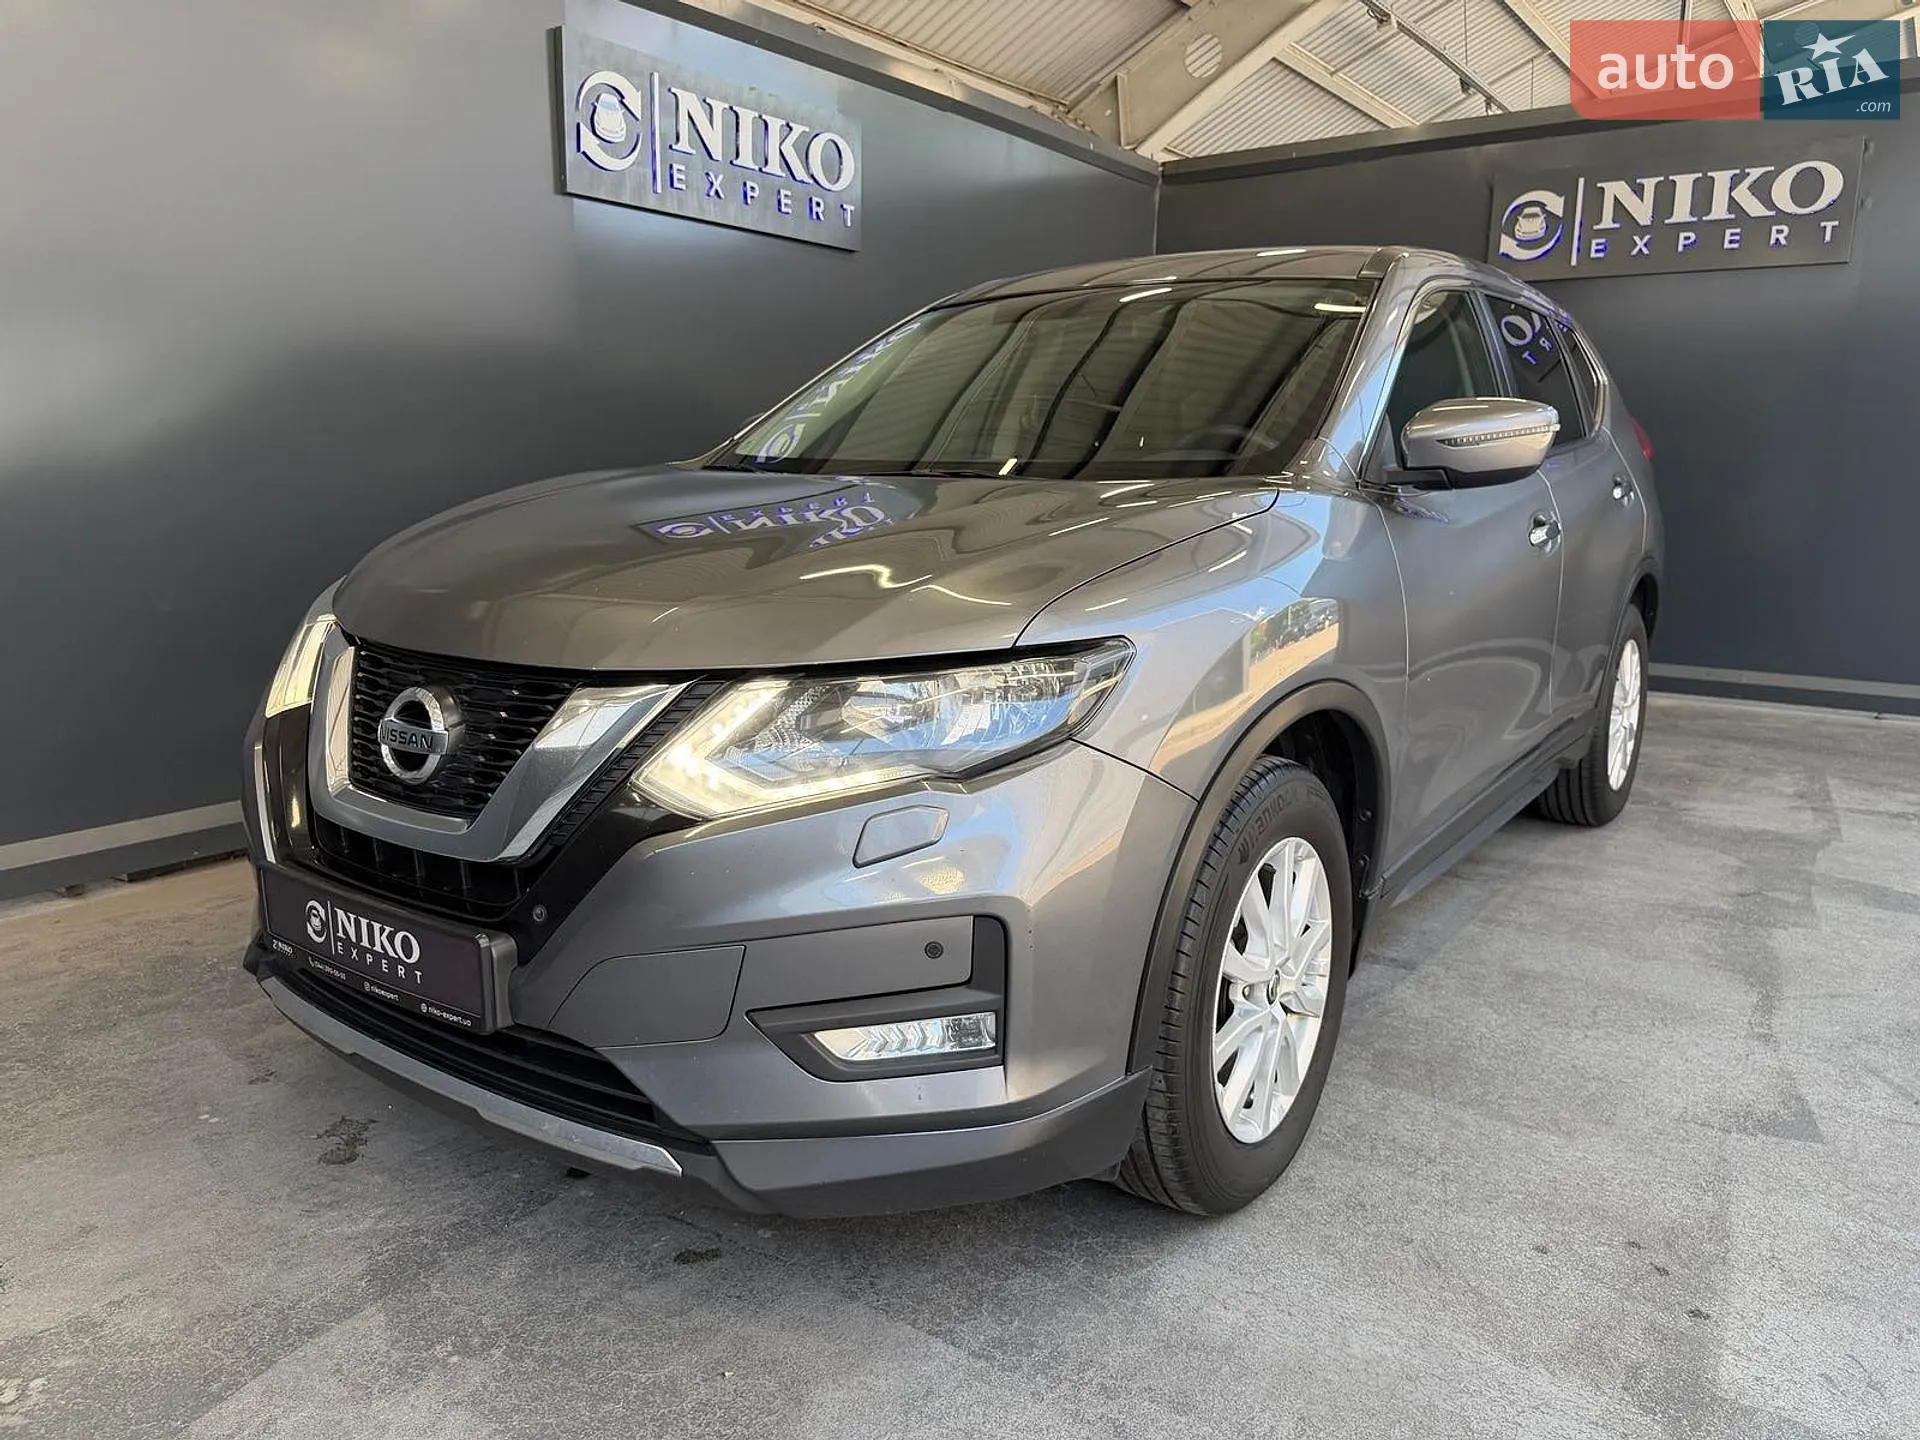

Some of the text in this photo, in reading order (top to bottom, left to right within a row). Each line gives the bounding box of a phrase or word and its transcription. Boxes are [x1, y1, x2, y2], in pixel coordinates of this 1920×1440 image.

[668, 86, 856, 192] NIKO
[668, 163, 855, 227] EXPERT
[1592, 160, 1844, 231] NIKO
[1590, 221, 1840, 258] EXPERT
[333, 907, 421, 965] NIKO
[337, 941, 424, 984] EXPERT
